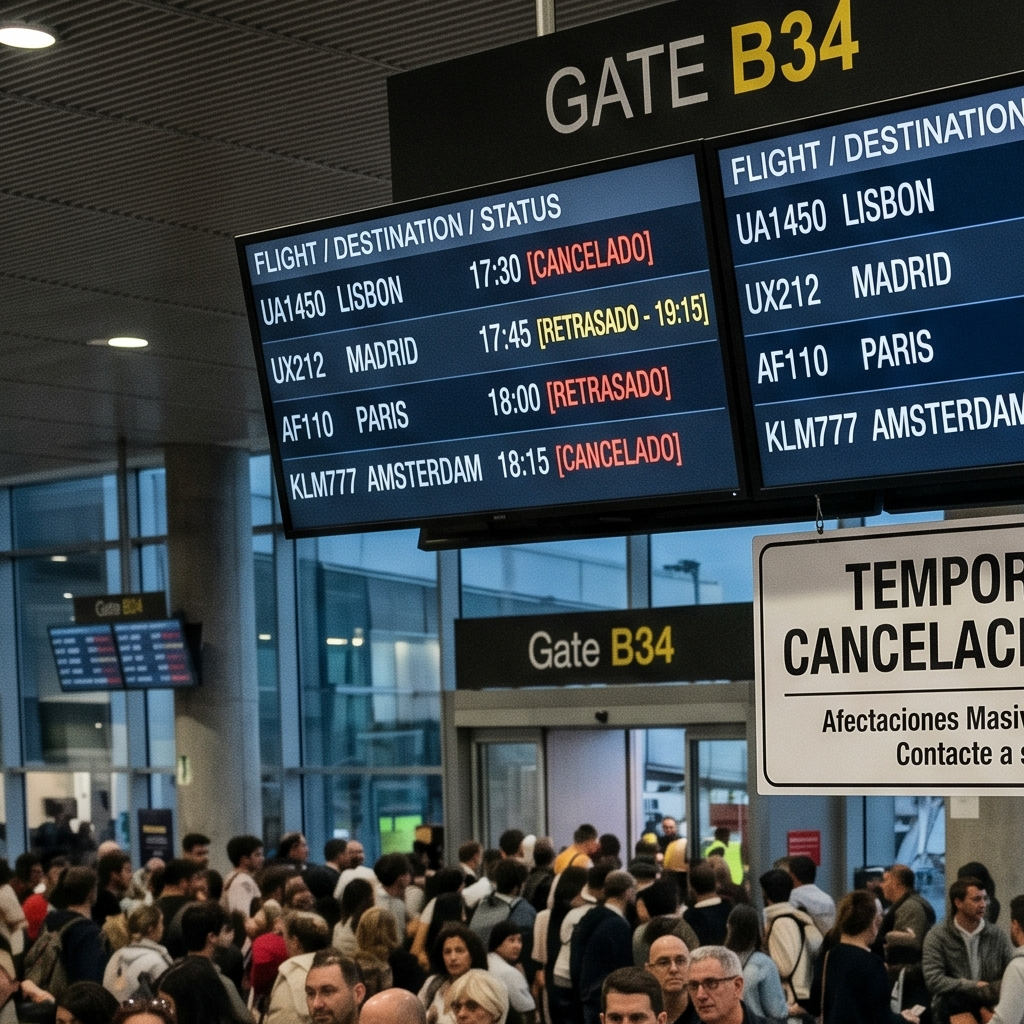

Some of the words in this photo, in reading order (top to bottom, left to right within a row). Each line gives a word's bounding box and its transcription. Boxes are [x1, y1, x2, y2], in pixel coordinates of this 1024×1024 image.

[545, 34, 709, 134] GATE
[731, 0, 859, 95] B34
[731, 140, 821, 186] FLIGHT
[829, 135, 836, 166] /
[254, 241, 317, 275] FLIGHT
[324, 238, 328, 263] /
[334, 212, 463, 260] DESTINATION
[468, 208, 474, 234] /
[481, 193, 561, 231] STATUS
[736, 199, 827, 245] UA1450
[842, 178, 934, 226] LISBON
[260, 289, 326, 326] UA1450
[338, 275, 403, 312] LISBON
[469, 254, 522, 289] 17:30
[526, 231, 654, 285] [CANCELADO]
[745, 273, 821, 316] UX212
[852, 251, 951, 299] MADRID
[271, 352, 326, 384] UX212
[346, 336, 419, 373] MADRID
[479, 319, 531, 352] 17:45
[536, 303, 639, 349] [RETRASADO
[655, 293, 709, 327] 19:15]
[757, 344, 828, 384] AF110
[861, 329, 933, 370] PARIS
[281, 410, 334, 442] AF110
[356, 400, 409, 433] PARIS
[488, 383, 541, 416] 18:00
[546, 367, 671, 414] [RETRASADO]
[765, 412, 857, 453] KLM777
[290, 467, 356, 500] KLM777
[367, 454, 482, 492] AMSTERDAM
[498, 447, 550, 479] 18:15
[555, 433, 682, 477] [CANCELADO]
[528, 631, 600, 670] Gate
[611, 626, 674, 666] B34
[822, 707, 959, 733] Afectaciones
[897, 741, 992, 766] Contacte
[1000, 746, 1012, 765] a
